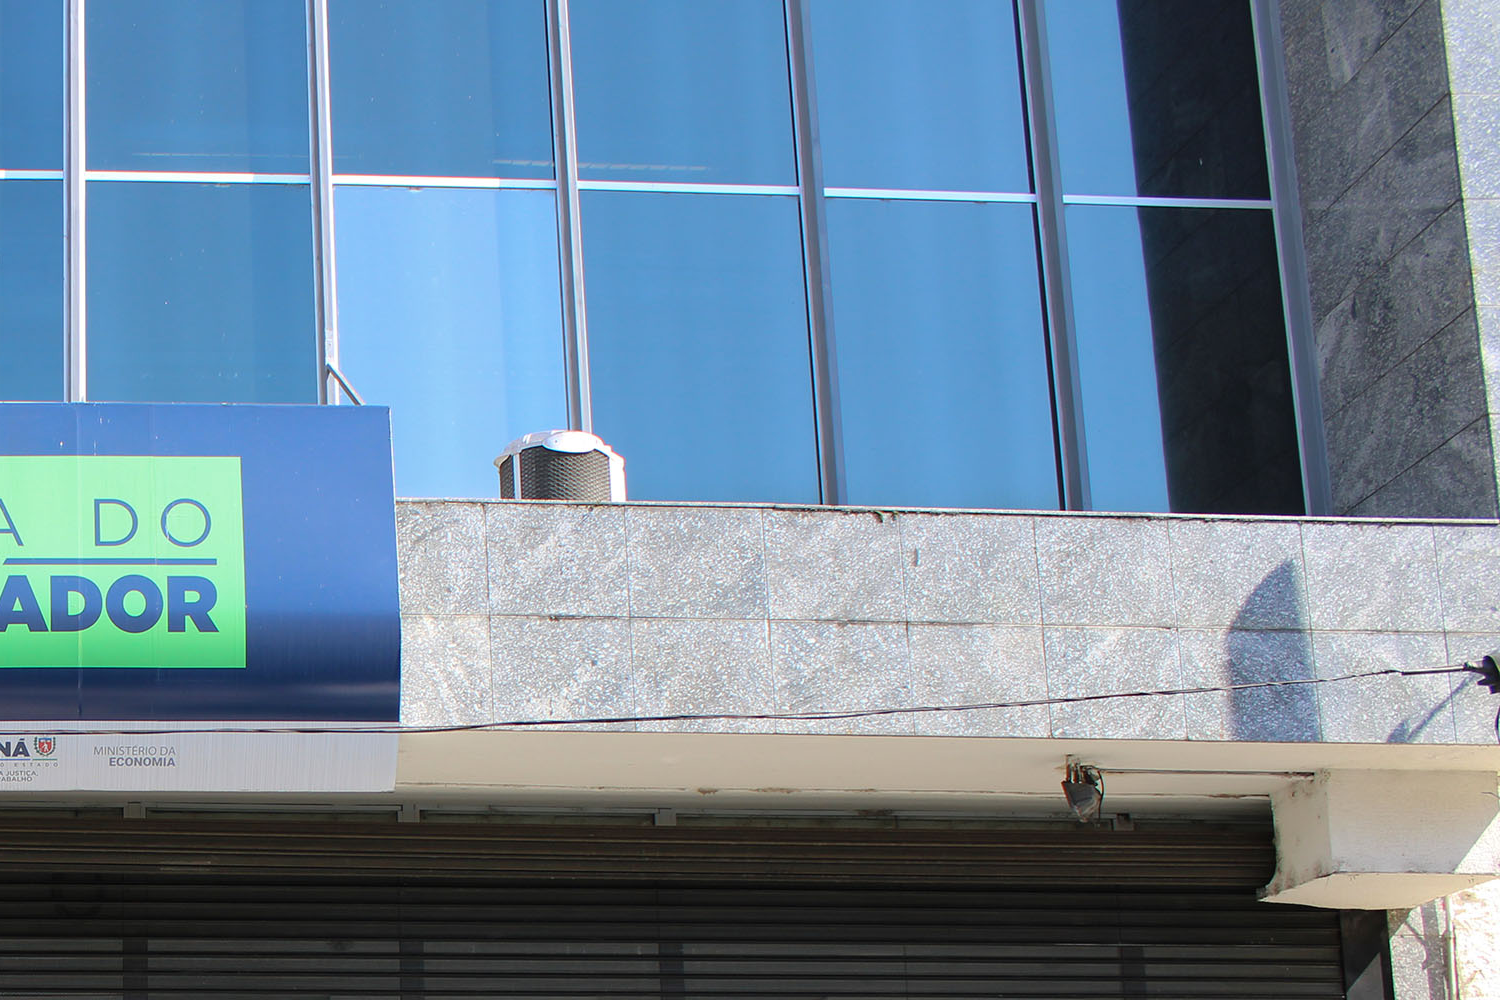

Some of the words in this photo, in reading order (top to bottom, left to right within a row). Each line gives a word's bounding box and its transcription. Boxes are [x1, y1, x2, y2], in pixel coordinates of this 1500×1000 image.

[95, 498, 213, 550] DO
[93, 745, 158, 756] MINISTÉRIO
[159, 747, 177, 756] DA
[108, 757, 176, 767] ECONOMIA
